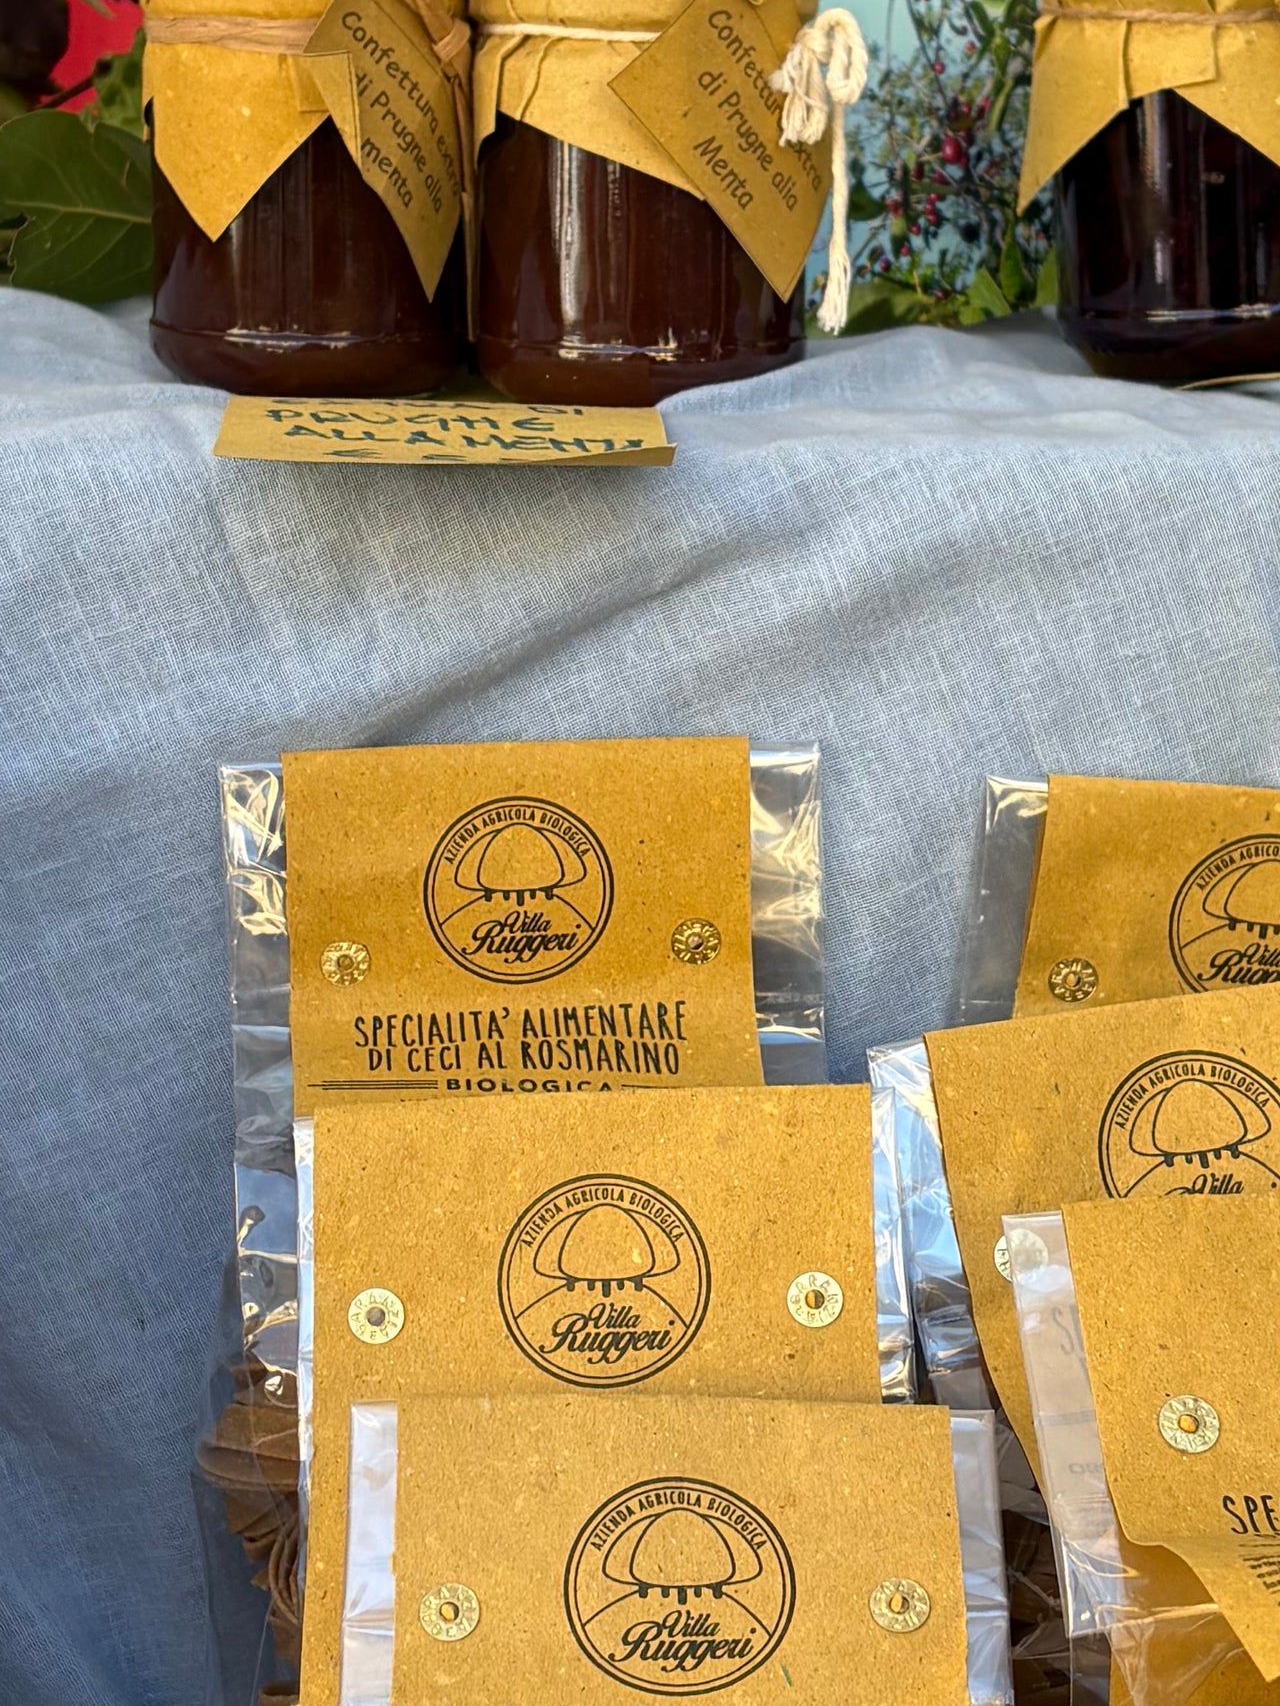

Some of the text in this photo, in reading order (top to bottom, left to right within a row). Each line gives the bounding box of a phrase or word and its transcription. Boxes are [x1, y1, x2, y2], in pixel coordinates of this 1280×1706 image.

[342, 11, 438, 135] Confettura
[370, 91, 427, 173] Prugne
[697, 71, 727, 96] di
[718, 91, 773, 172] Prugne
[693, 136, 754, 210] Menta
[443, 808, 591, 865] AZIENDA AGRICOLA BIOLOGICA
[461, 920, 581, 964] Ruggeri
[504, 910, 552, 934] Villa
[354, 1000, 687, 1048] SPECIALITA' ALIMENTARE
[369, 1038, 678, 1074] DI CECI AL ROSMARINO
[446, 1078, 612, 1093] BIOLOGICA
[521, 1187, 685, 1248] AZIENDA AGRICOLA BIOLOGICA
[539, 1312, 676, 1365] Ruggeri
[588, 1302, 641, 1329] Villa
[590, 1490, 768, 1551] AZIENDA AGRICOLA BIOLOGICA
[608, 1620, 758, 1672] Ruggeri
[661, 1610, 720, 1640] Villa
